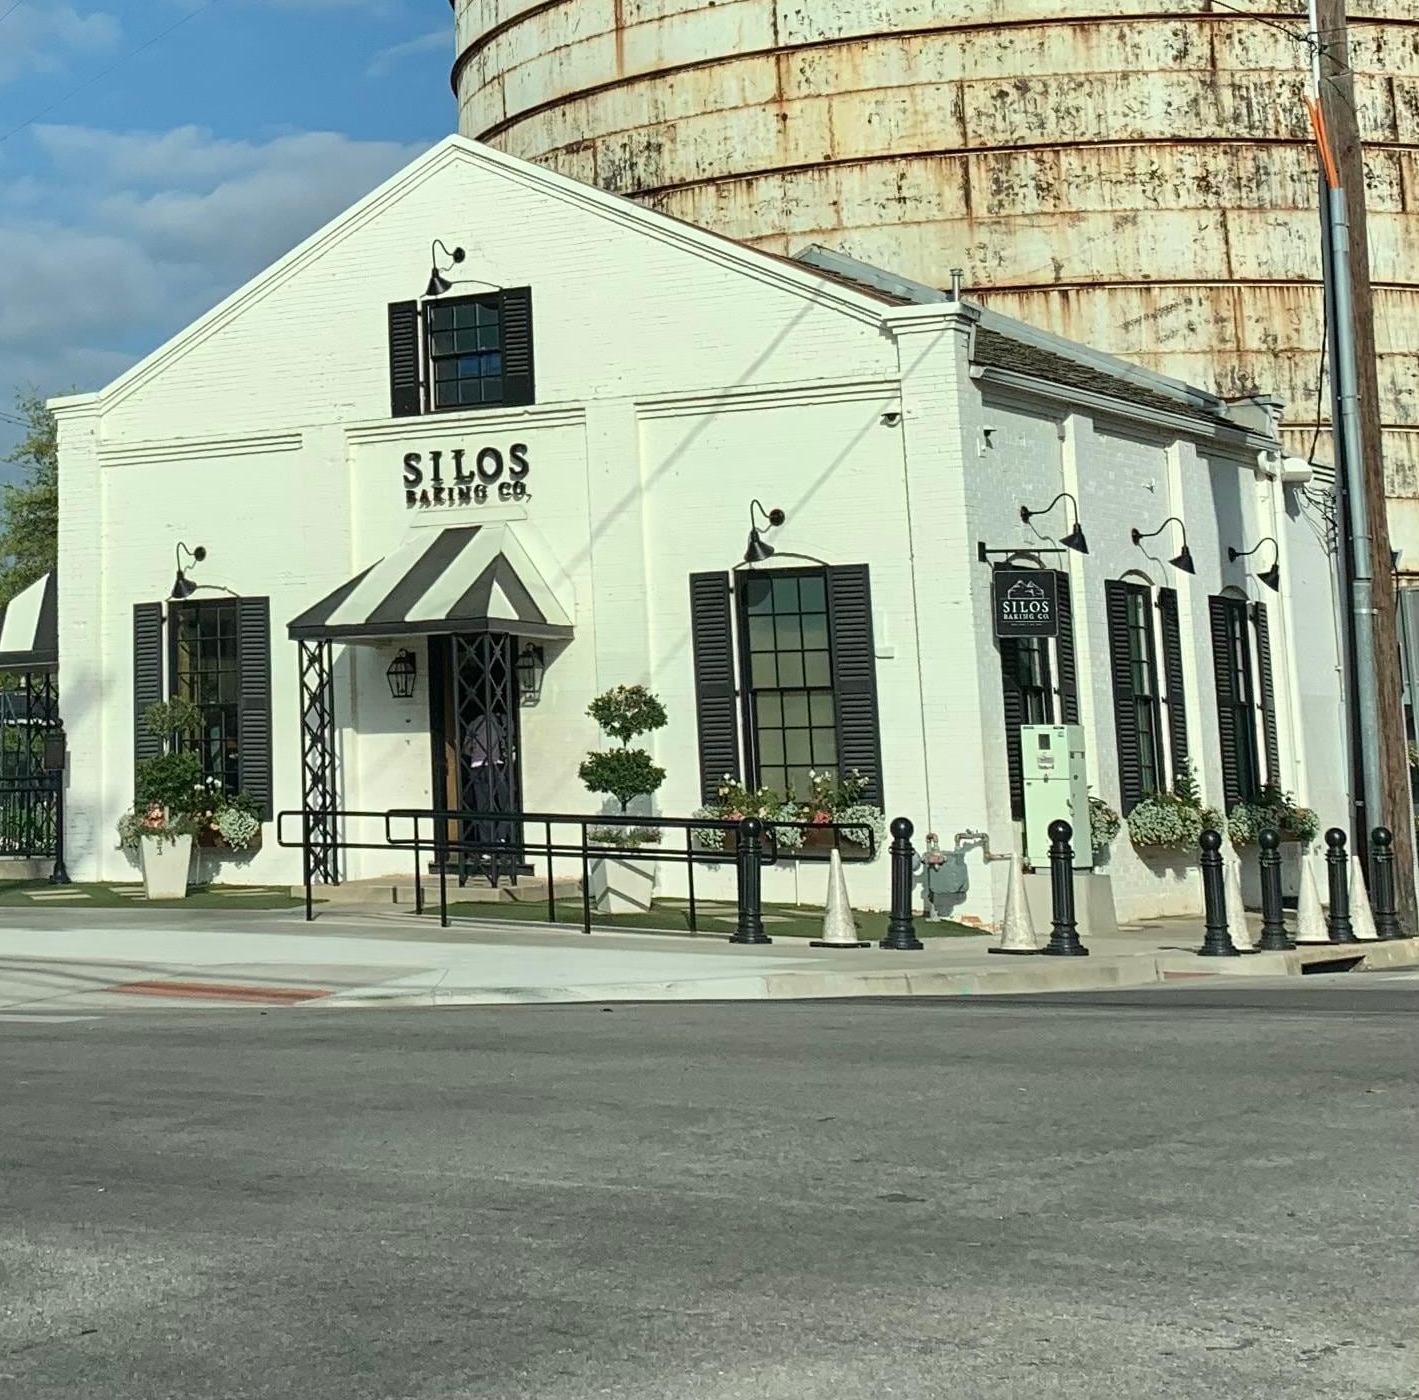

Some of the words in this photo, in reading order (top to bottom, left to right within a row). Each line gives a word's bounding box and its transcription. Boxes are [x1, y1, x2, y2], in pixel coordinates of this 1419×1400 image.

[403, 443, 530, 488] SILOS
[405, 484, 488, 508] BAKING
[1002, 601, 1049, 613] SILOS
